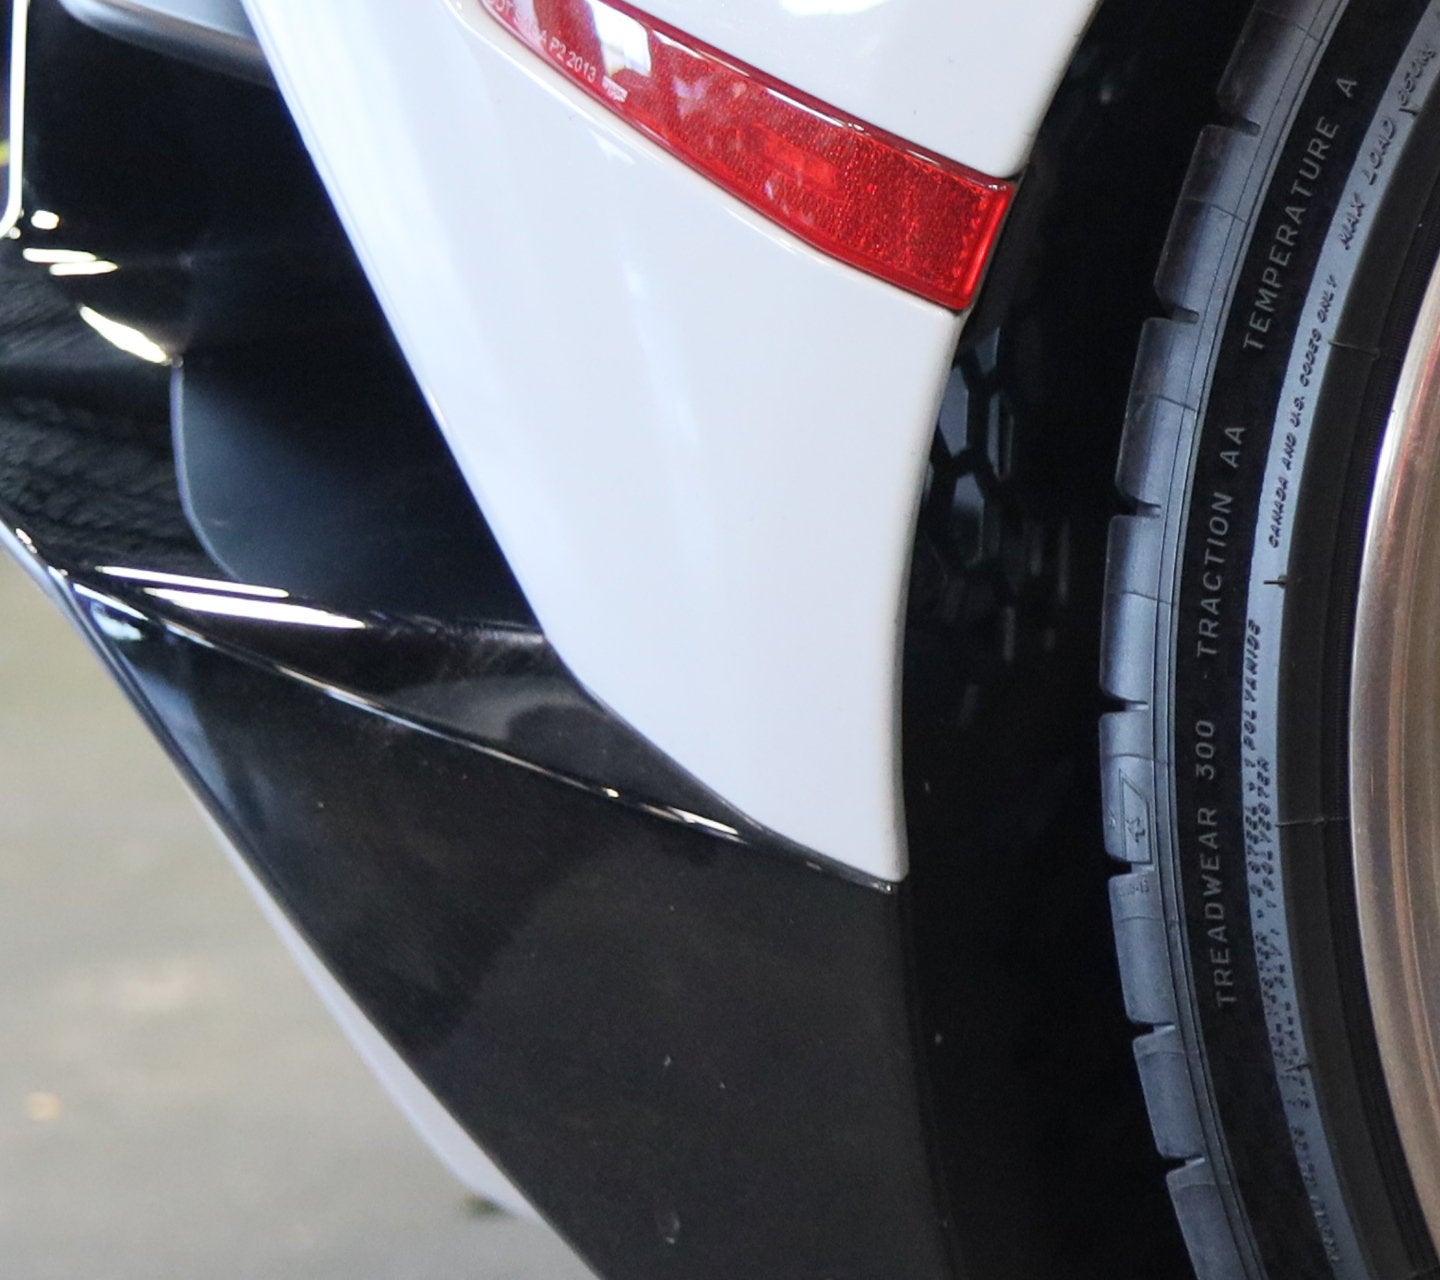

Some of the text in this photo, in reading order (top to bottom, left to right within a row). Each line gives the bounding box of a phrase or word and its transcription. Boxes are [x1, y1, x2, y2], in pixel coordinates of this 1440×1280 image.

[566, 51, 597, 84] 2013
[1194, 71, 1360, 1010] TREADWEAR 300 TRACTION AA TEMPERATURE A
